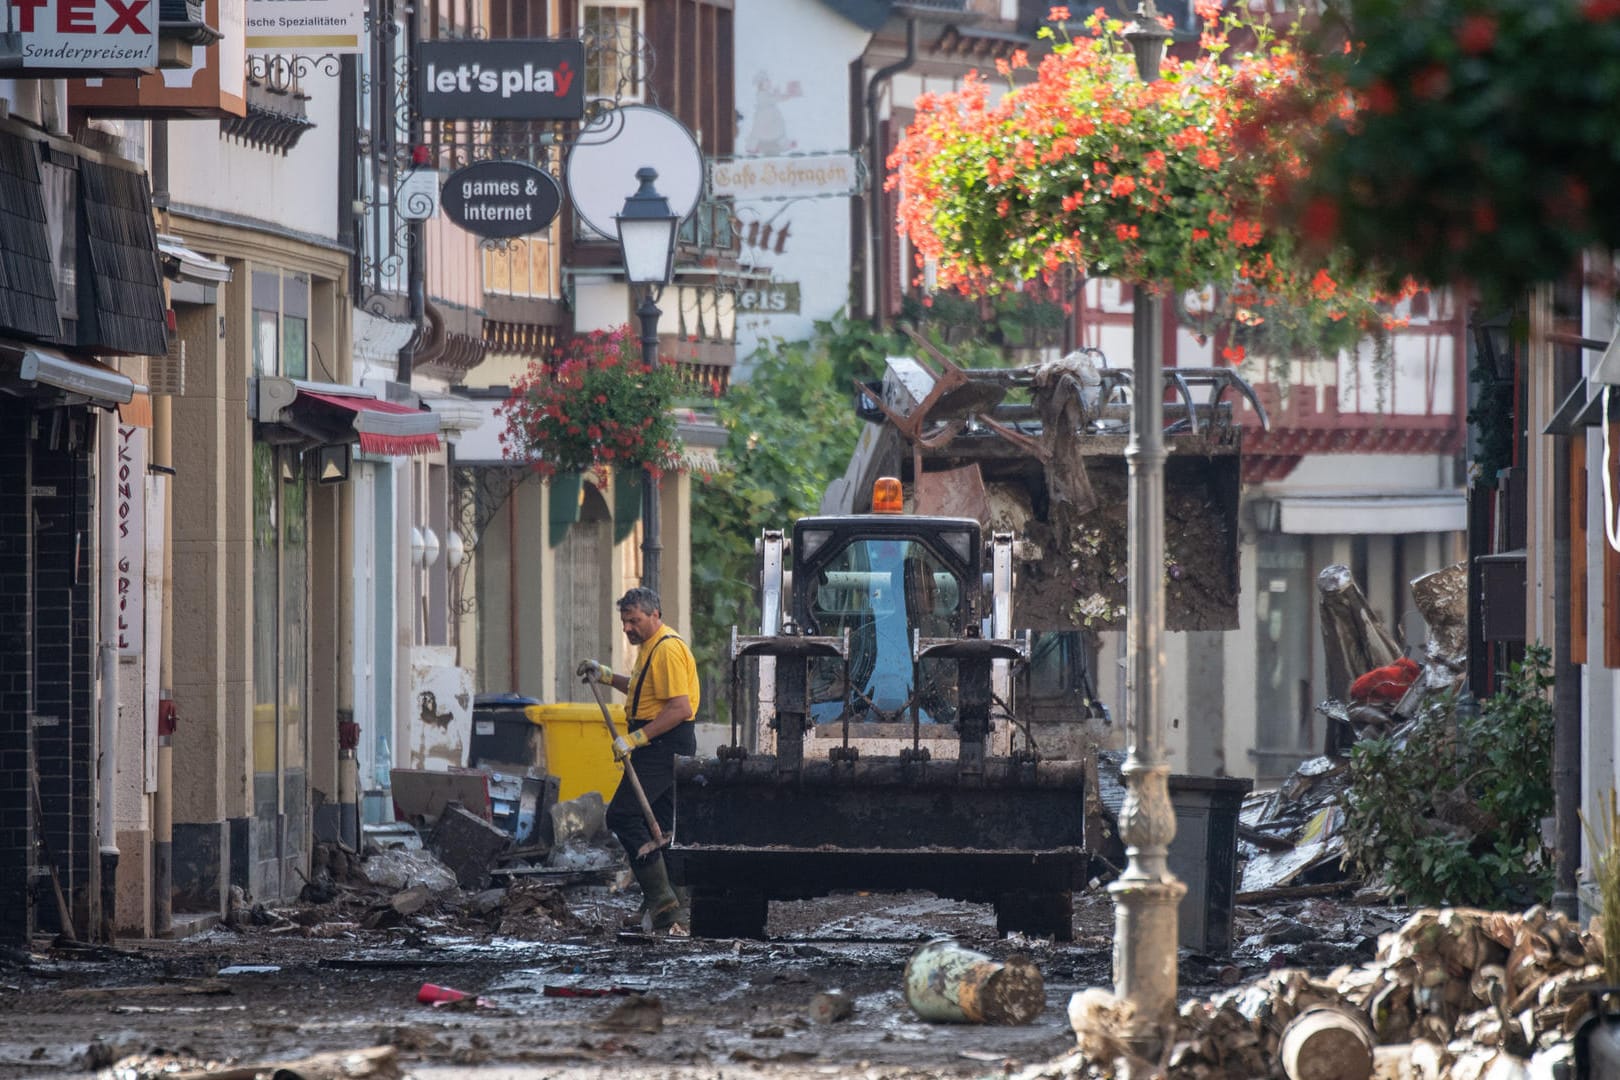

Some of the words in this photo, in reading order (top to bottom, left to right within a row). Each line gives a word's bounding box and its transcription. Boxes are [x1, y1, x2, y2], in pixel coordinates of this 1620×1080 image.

[246, 17, 276, 27] ische
[279, 16, 347, 28] Spezialitäten
[22, 41, 153, 63] Sonderpreisen!
[427, 63, 498, 93] let's
[502, 60, 574, 98] play
[462, 181, 520, 199] games
[525, 178, 538, 196] &
[464, 203, 532, 221] internet
[118, 427, 136, 538] YKONOS
